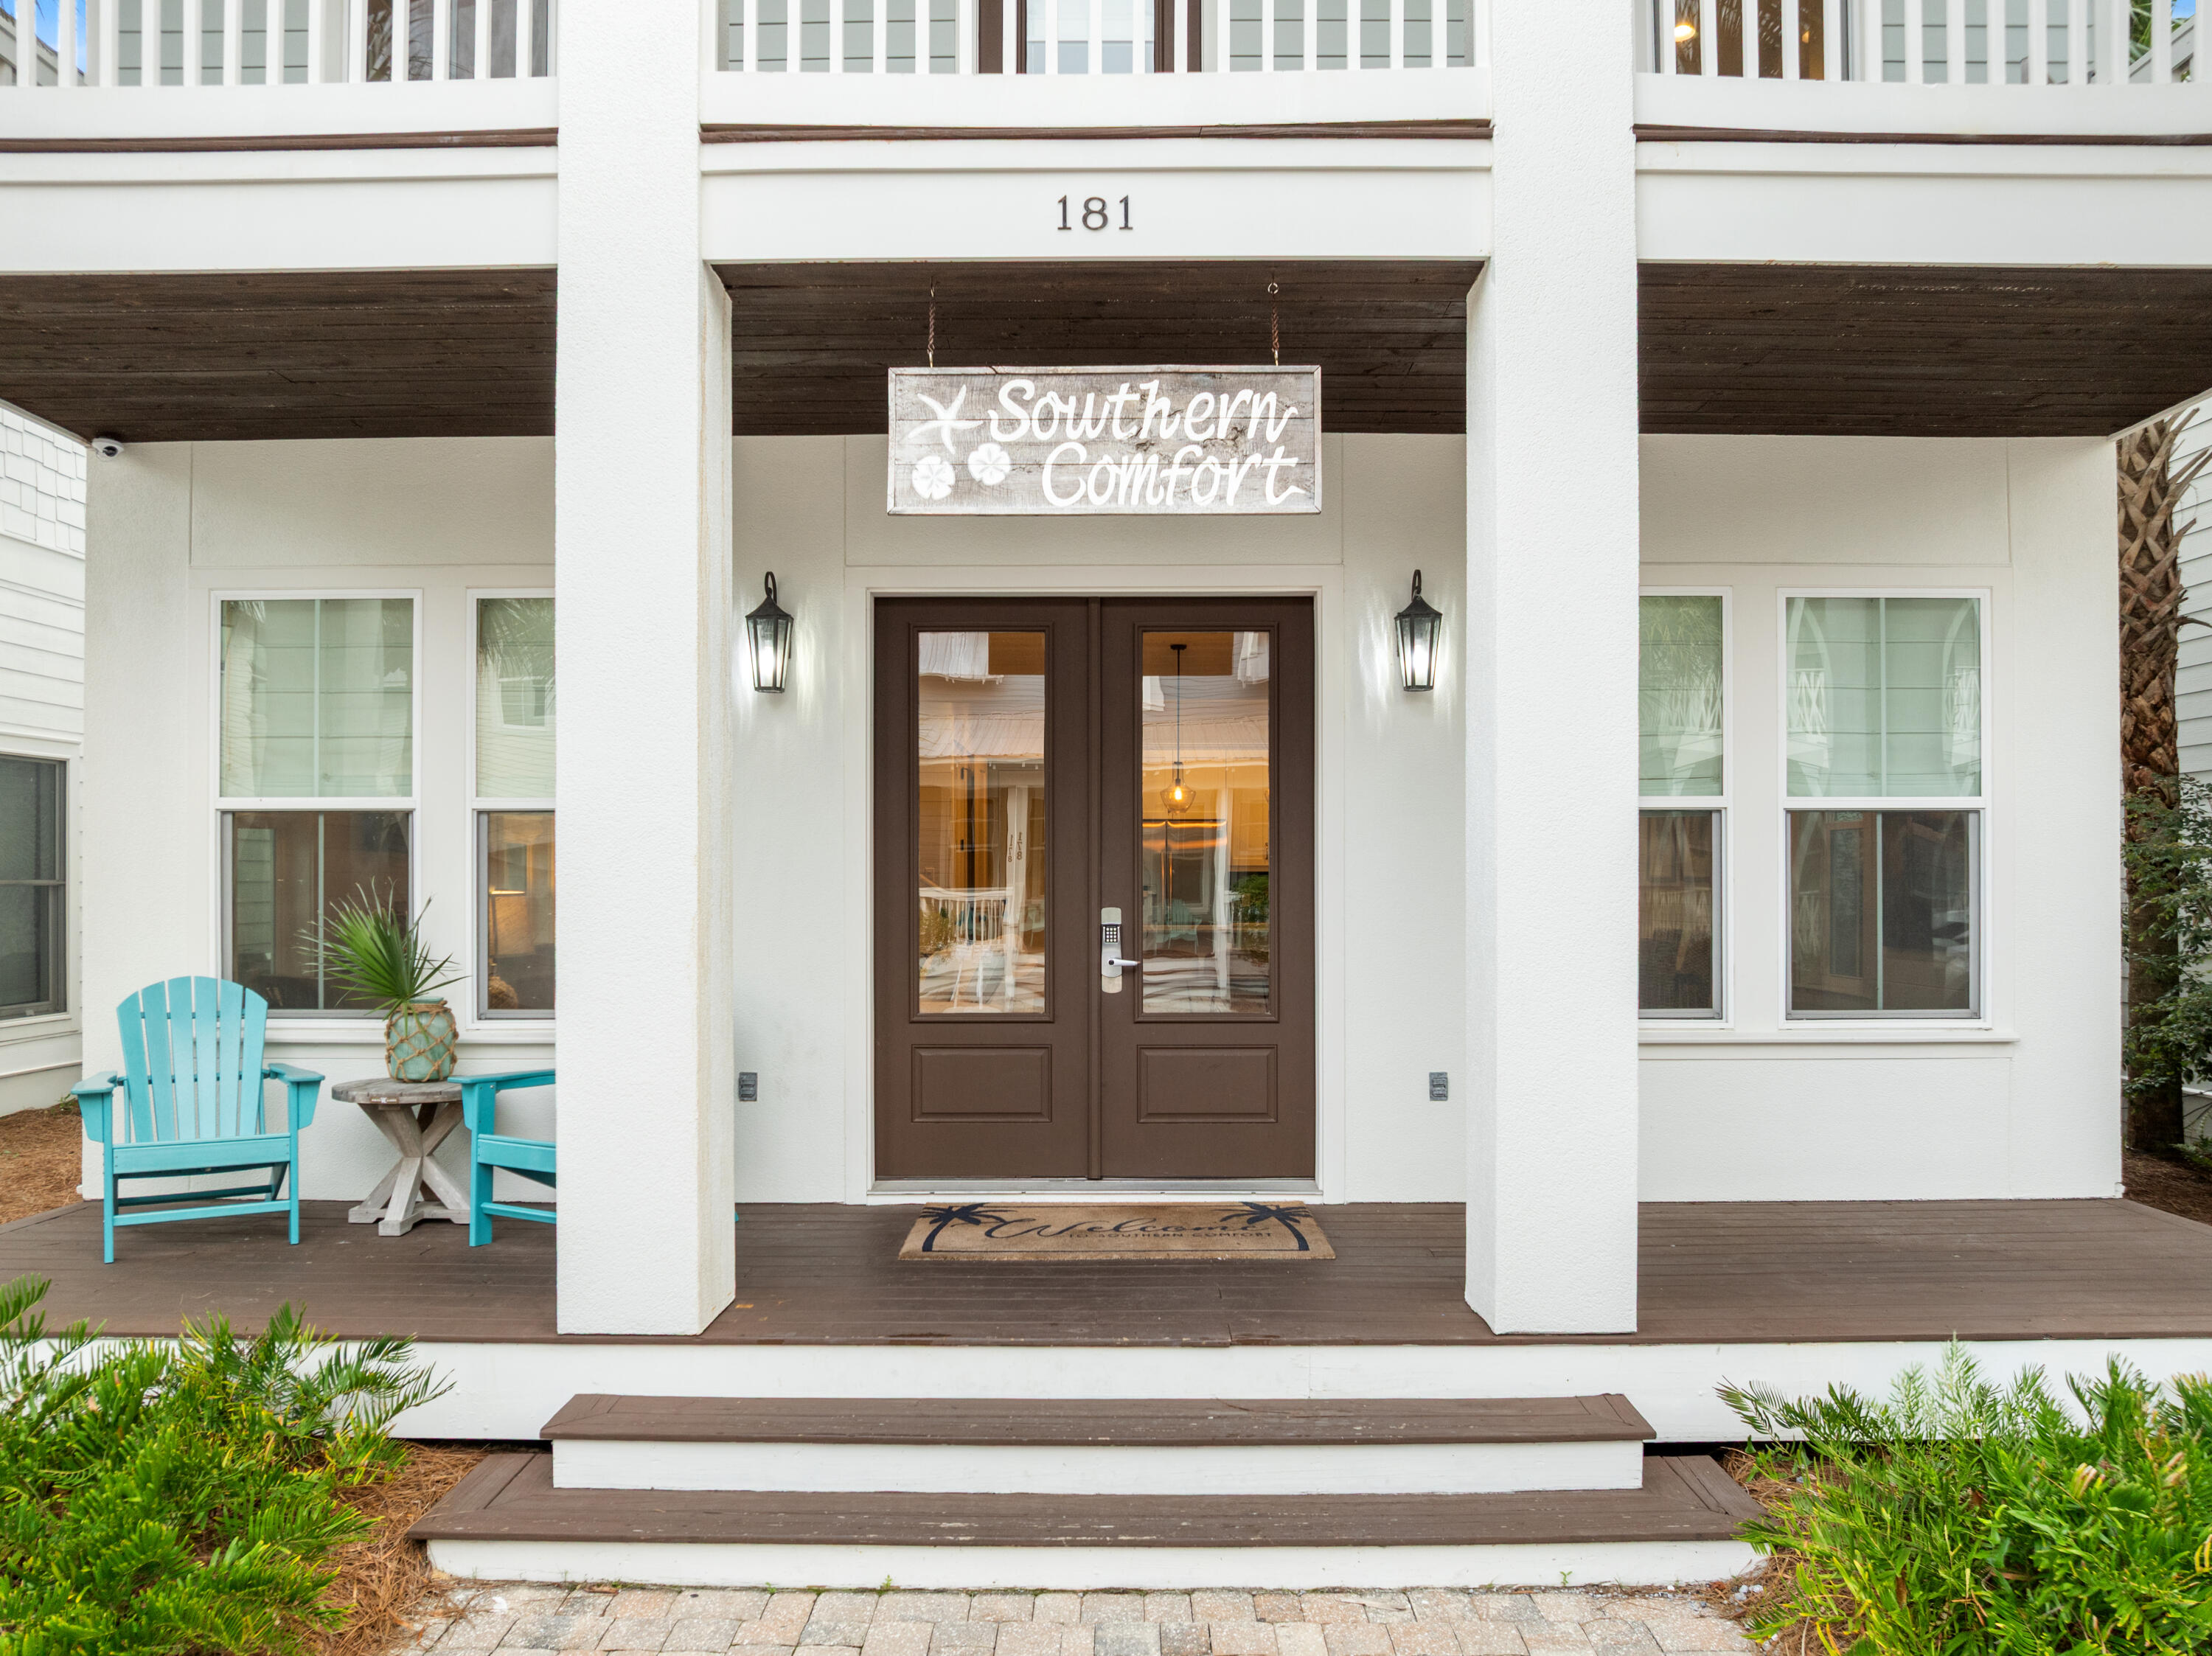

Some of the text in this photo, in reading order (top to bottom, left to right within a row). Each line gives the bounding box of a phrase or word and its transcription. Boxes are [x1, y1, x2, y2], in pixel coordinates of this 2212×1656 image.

[1057, 194, 1134, 231] 181
[987, 378, 1298, 443] Southern
[1041, 442, 1306, 507] Comfort
[950, 1218, 1270, 1239] Welcome
